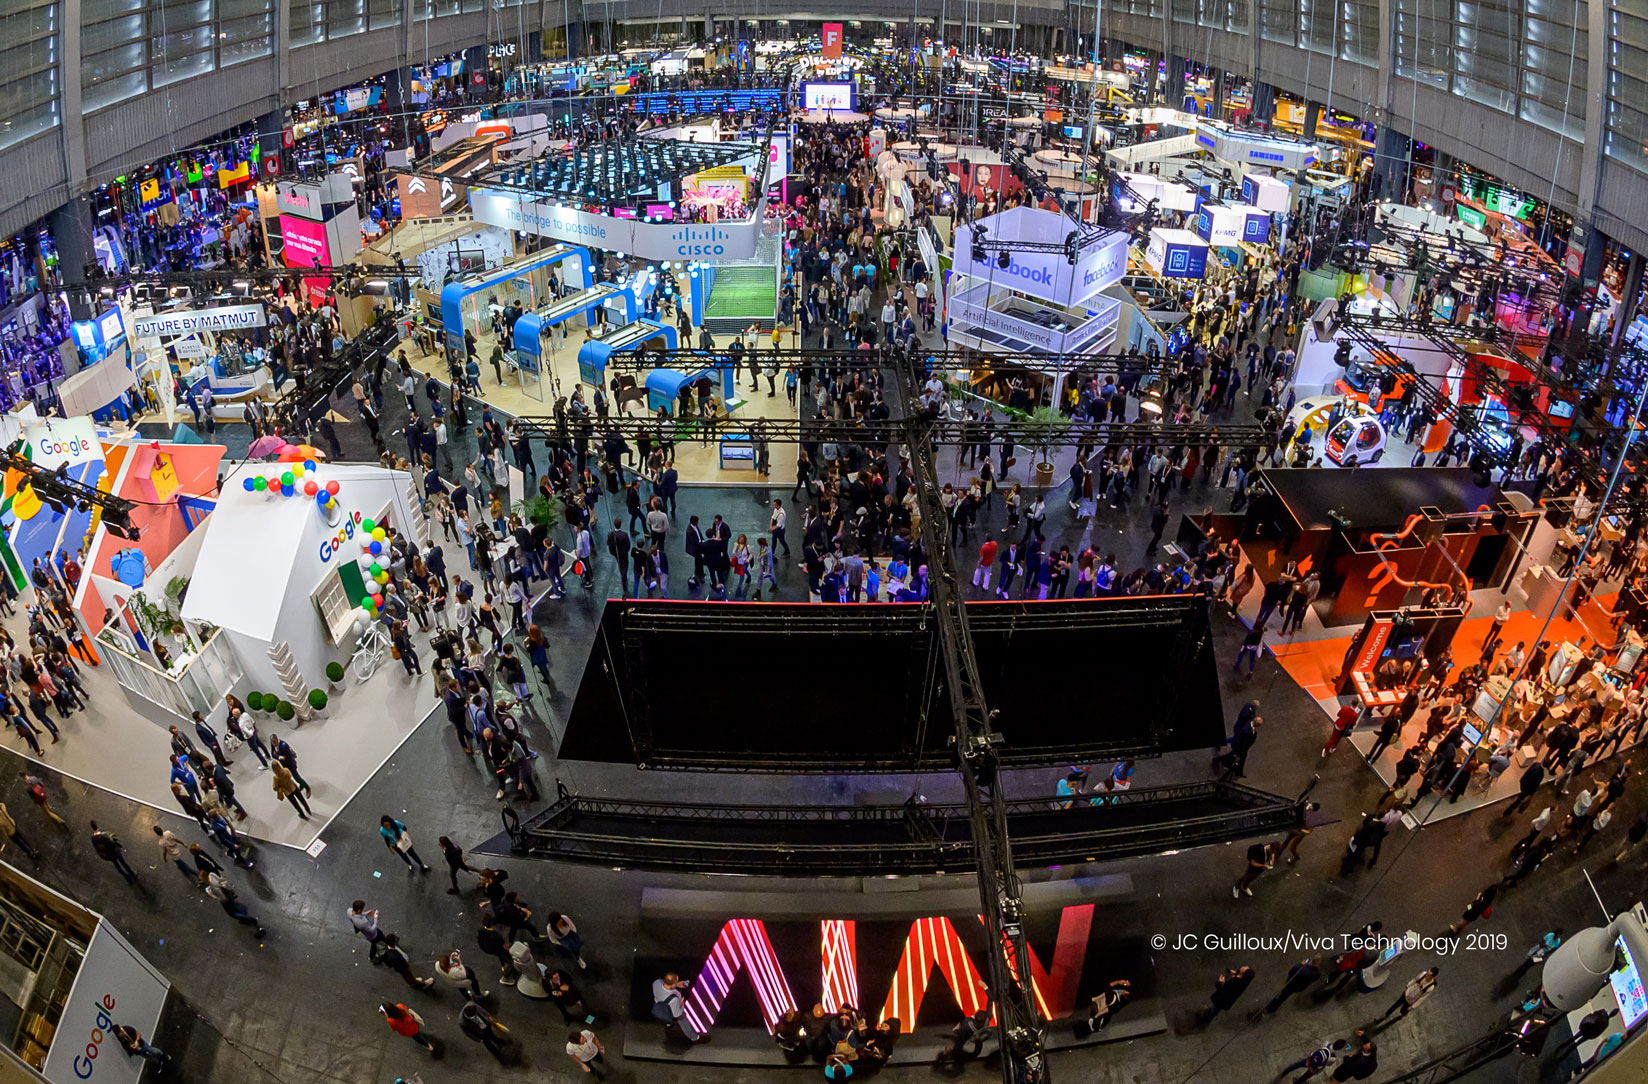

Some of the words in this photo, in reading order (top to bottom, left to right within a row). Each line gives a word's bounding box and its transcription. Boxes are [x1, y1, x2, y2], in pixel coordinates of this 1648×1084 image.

[827, 31, 838, 47] F
[506, 207, 522, 223] The
[522, 210, 551, 230] bridge
[553, 218, 564, 231] to
[565, 222, 607, 241] possible
[1214, 229, 1237, 237] KPMG
[678, 244, 725, 256] CISCO
[1148, 247, 1162, 263] KPMG
[974, 255, 1053, 287] acbook
[1083, 254, 1119, 288] facebook
[135, 319, 182, 335] FUTURE
[182, 316, 198, 329] BY
[201, 311, 257, 328] MATMUT
[963, 308, 999, 328] Artificial
[1000, 320, 1052, 345] Intelligence
[40, 435, 90, 457] Google
[319, 511, 362, 563] Google
[1359, 626, 1387, 669] Welcome
[73, 994, 116, 1080] Google
